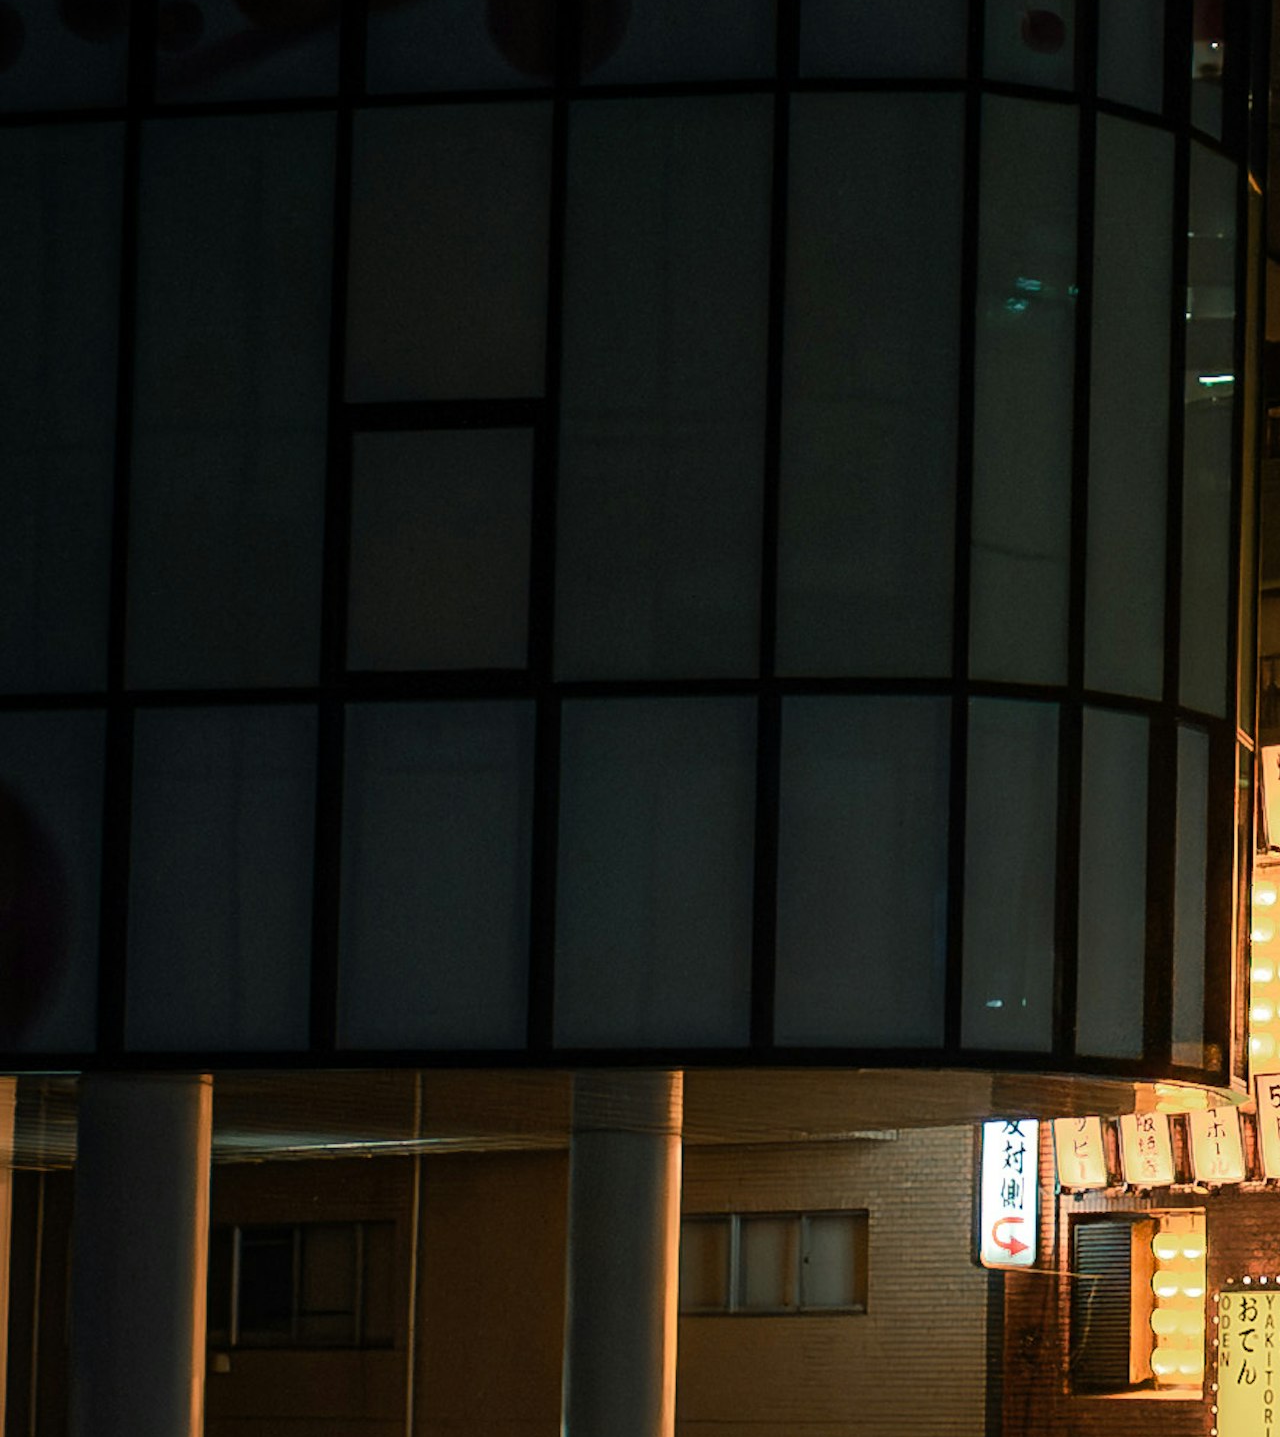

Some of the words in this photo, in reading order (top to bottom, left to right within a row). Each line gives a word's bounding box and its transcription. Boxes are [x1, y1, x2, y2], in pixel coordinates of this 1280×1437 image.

[1000, 1120, 1026, 1210] 反対側
[1220, 1295, 1231, 1367] ODEN
[1237, 1296, 1259, 1385] おでん
